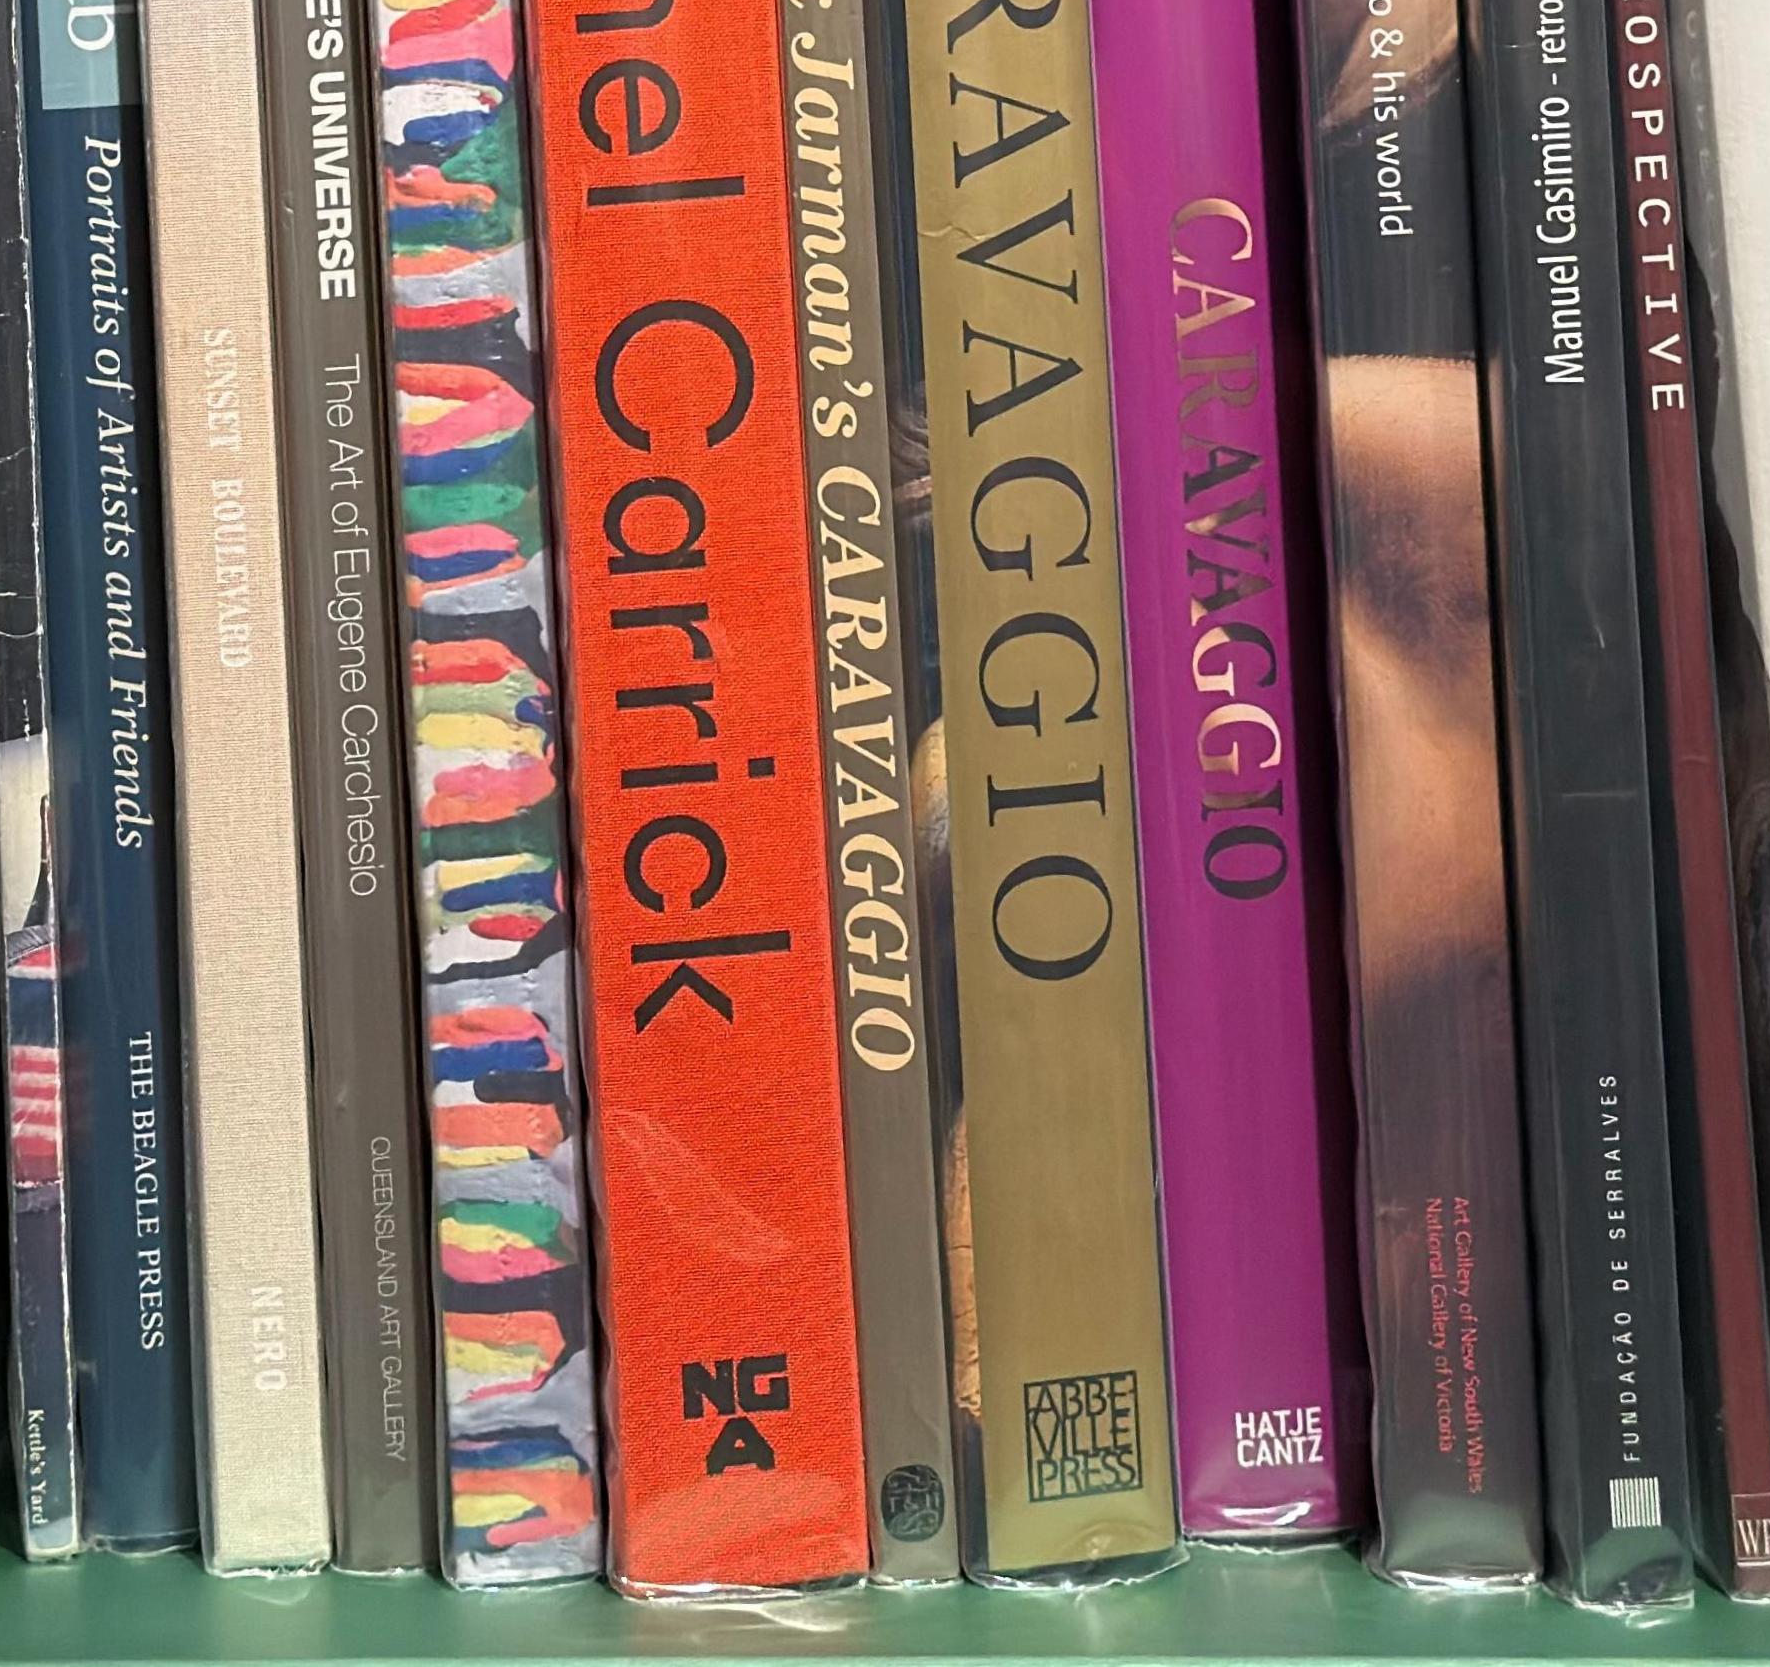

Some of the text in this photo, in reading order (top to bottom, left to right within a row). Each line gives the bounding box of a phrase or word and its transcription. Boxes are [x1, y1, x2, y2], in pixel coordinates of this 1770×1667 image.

[1370, 29, 1404, 59] &
[1371, 71, 1405, 123] his
[307, 72, 356, 300] UNIVERSE
[1376, 130, 1413, 237] world
[1532, 96, 1579, 245] Casimiro
[323, 353, 359, 427] The
[1537, 255, 1585, 385] Manuel
[85, 136, 154, 850] Portraits of Artists and Friends
[203, 328, 252, 668] SUNSET BOULEVARD
[328, 439, 363, 492] Art
[330, 501, 368, 539] of
[327, 547, 370, 692] Eugene
[1170, 197, 1290, 902] CARAVAGGIO
[595, 299, 792, 1035] Carrick
[340, 703, 380, 896] Carchesio
[817, 466, 916, 1073] CARAVAGGIO
[129, 1030, 165, 1351] THE BEAGLE PRESS
[250, 1286, 288, 1391] NERO
[370, 1136, 405, 1461] QUEENSLAND ART GALLERY
[1426, 1198, 1456, 1452] National Gallery of Victoria
[1598, 1075, 1641, 1462] FUNDAÇÃO DE SERRALVES
[1032, 1376, 1132, 1413] ABBE
[1453, 1197, 1484, 1494] Art Gallery of New South Wales
[1038, 1452, 1136, 1497] PRESS
[1234, 1405, 1322, 1440] HATJE
[1237, 1437, 1323, 1468] CANTZ
[31, 1480, 48, 1524] Yard
